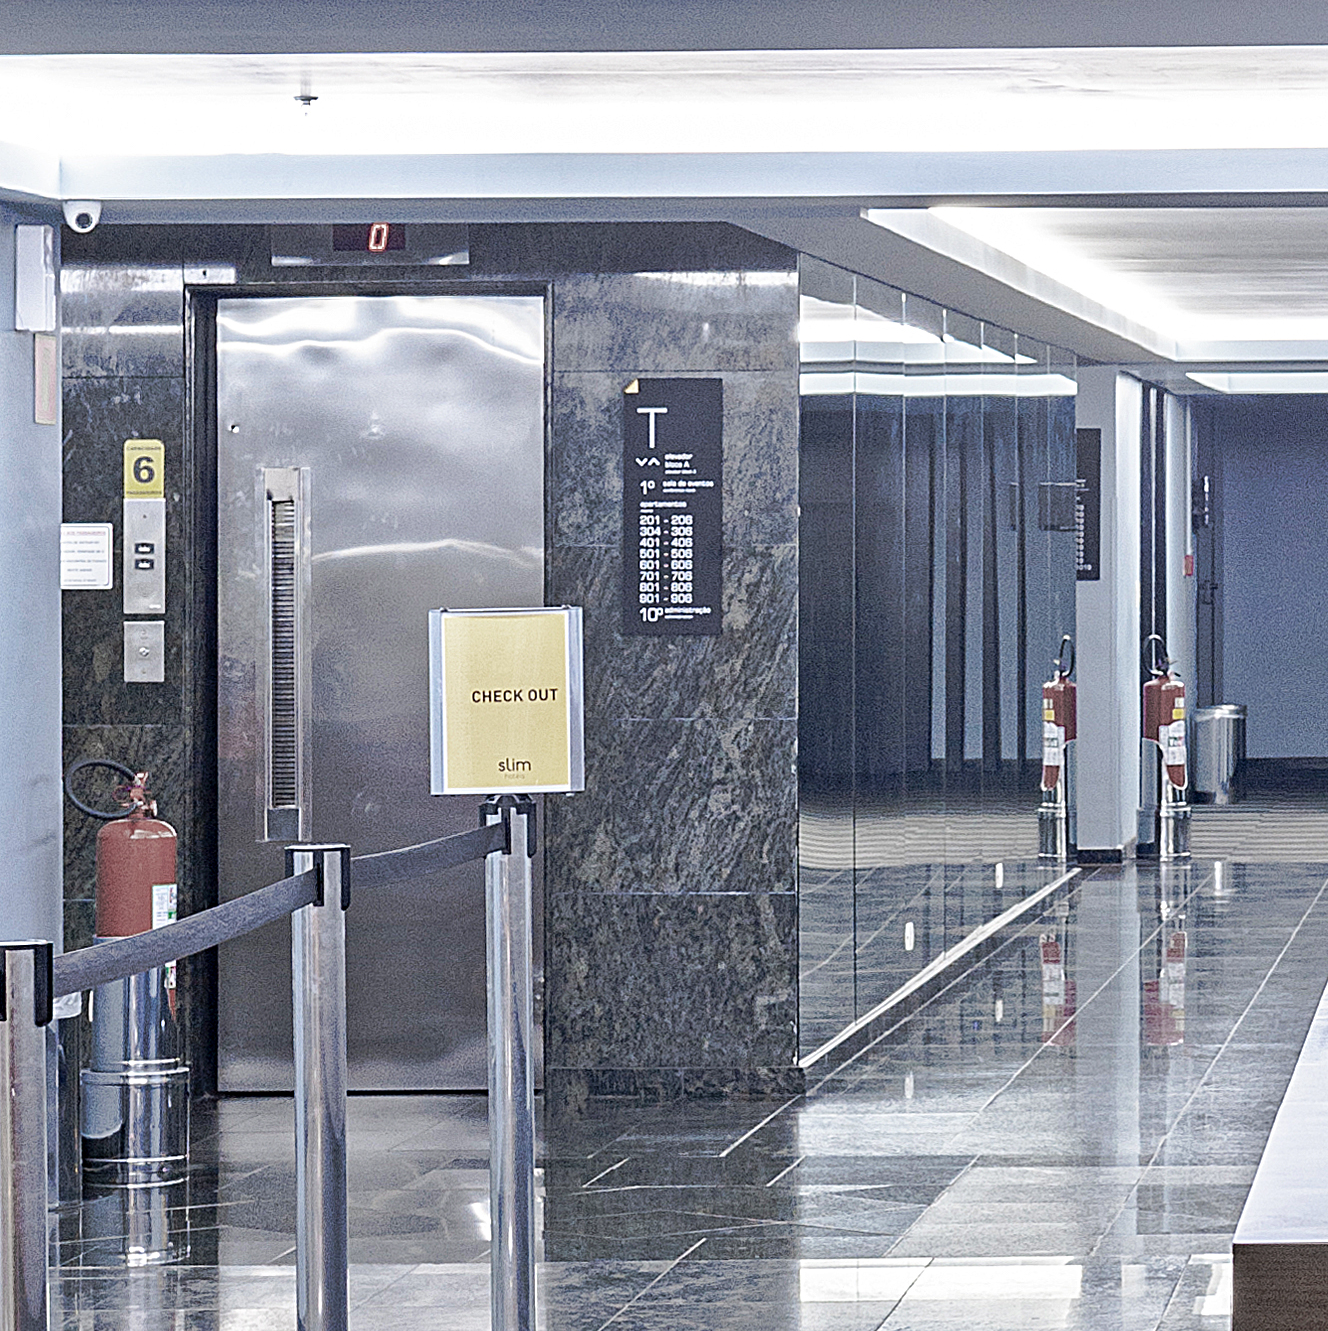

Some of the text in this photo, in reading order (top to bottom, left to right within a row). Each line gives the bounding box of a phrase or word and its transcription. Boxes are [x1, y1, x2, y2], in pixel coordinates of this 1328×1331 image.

[369, 222, 389, 251] 0
[636, 407, 668, 449] T
[133, 456, 155, 484] 6
[471, 688, 559, 704] CHECK OUT
[498, 757, 532, 772] slim
